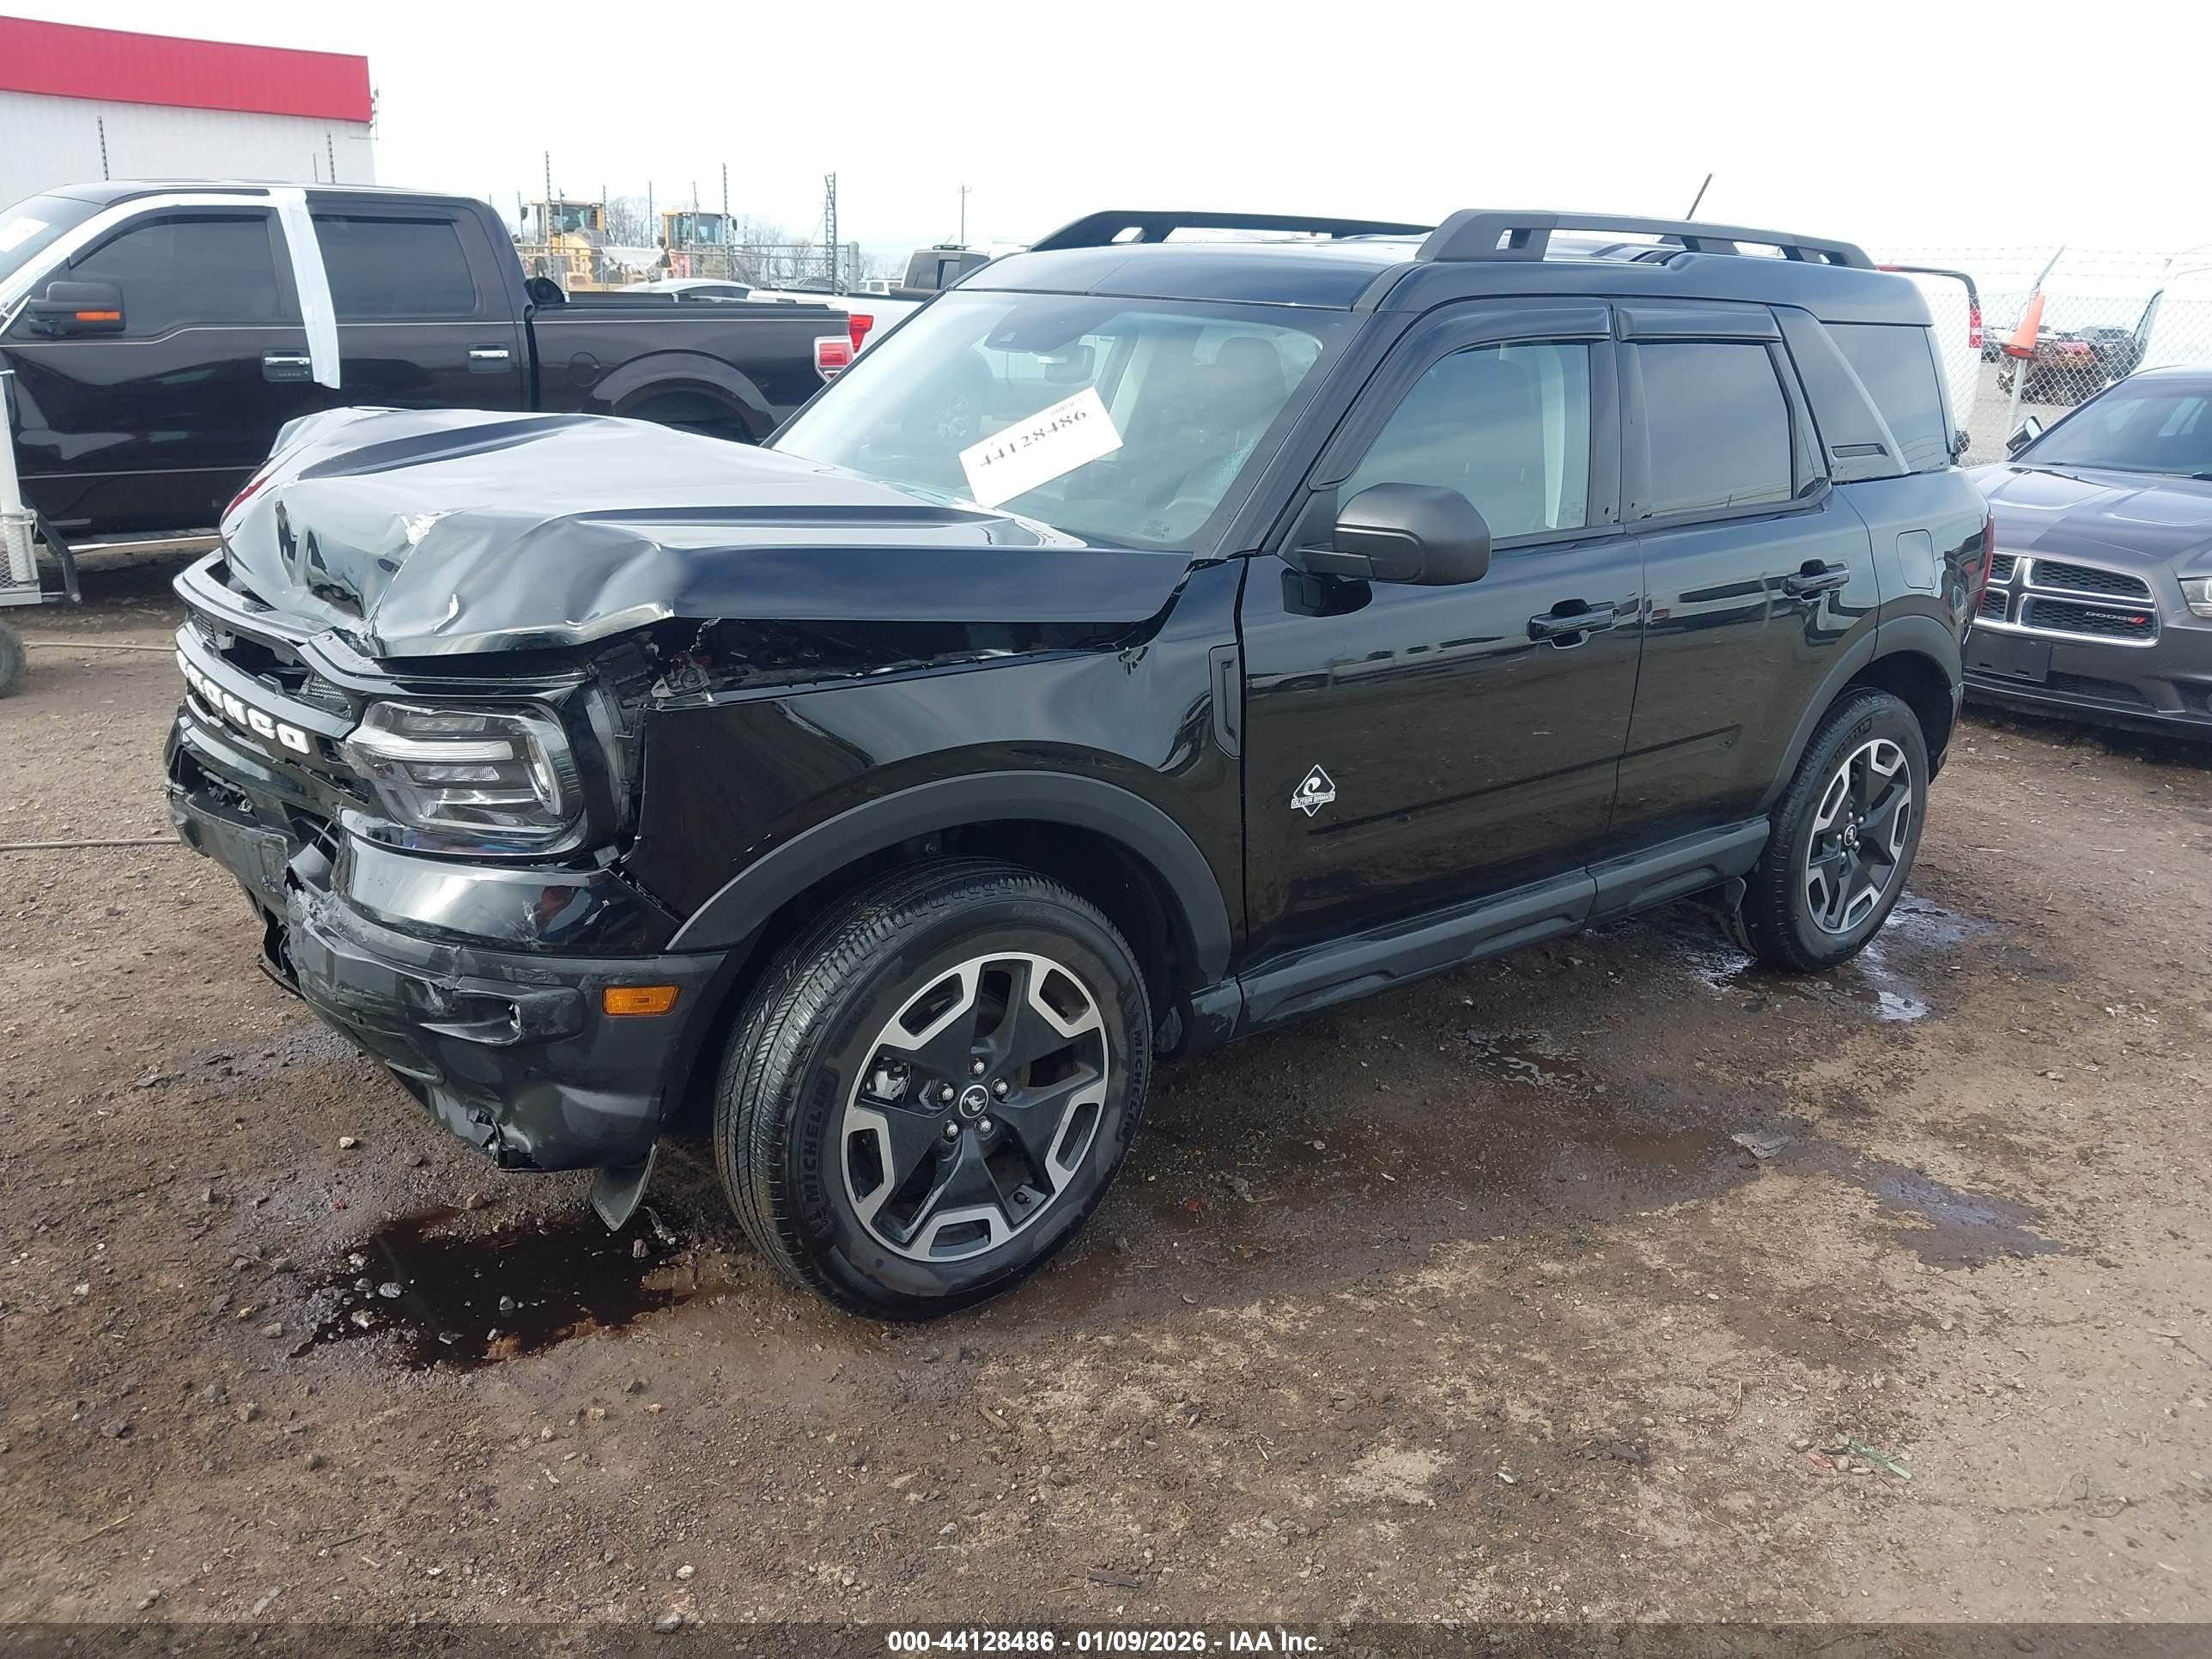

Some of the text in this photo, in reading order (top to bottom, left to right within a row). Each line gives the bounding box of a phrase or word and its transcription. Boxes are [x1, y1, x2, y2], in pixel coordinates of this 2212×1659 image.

[979, 409, 1087, 467] 44128486
[1292, 793, 1334, 806] OUTER BANKS
[1118, 1030, 1143, 1135] MICHELIN
[802, 1072, 832, 1202] MICHELIN
